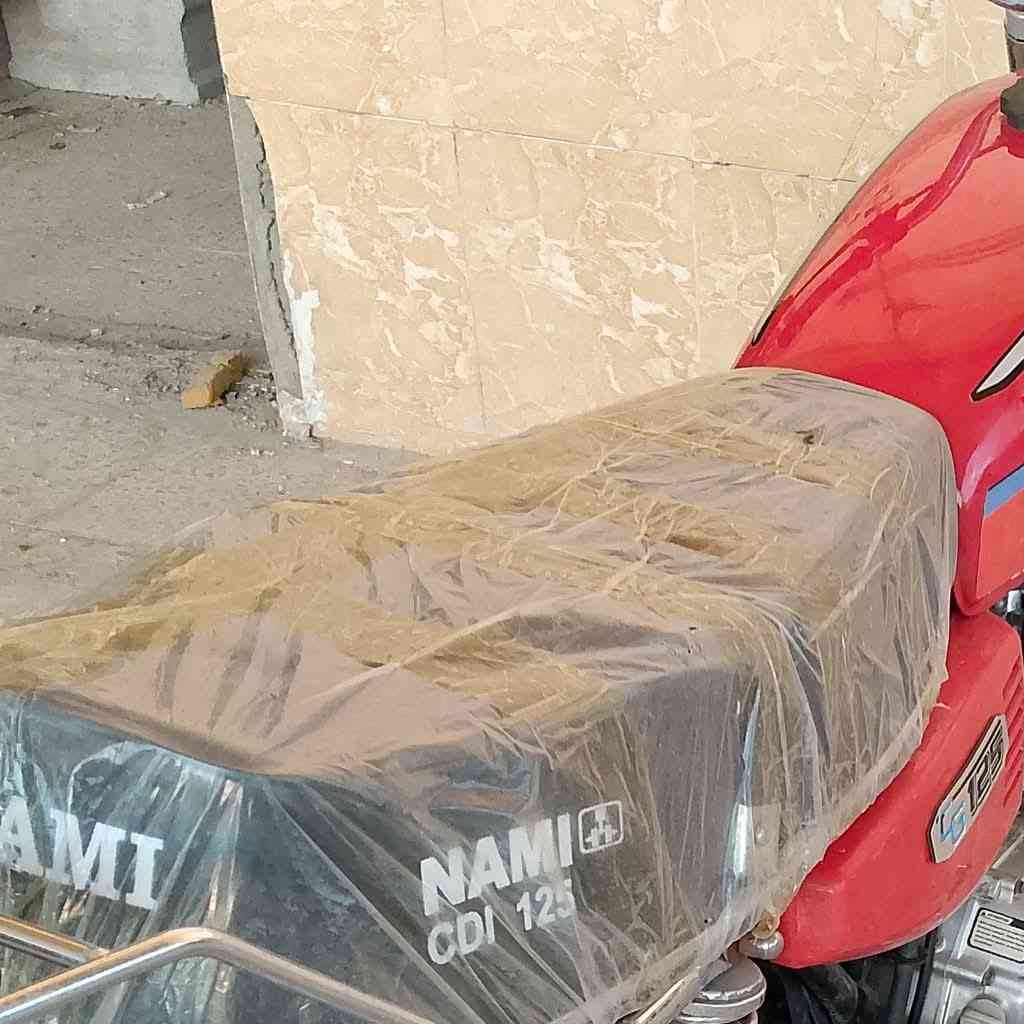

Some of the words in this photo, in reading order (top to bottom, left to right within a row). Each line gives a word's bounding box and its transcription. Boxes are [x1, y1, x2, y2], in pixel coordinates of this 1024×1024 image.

[967, 723, 1003, 813] 125
[420, 813, 573, 916] NAMI
[428, 905, 496, 965] CDI
[516, 878, 577, 931] 125
